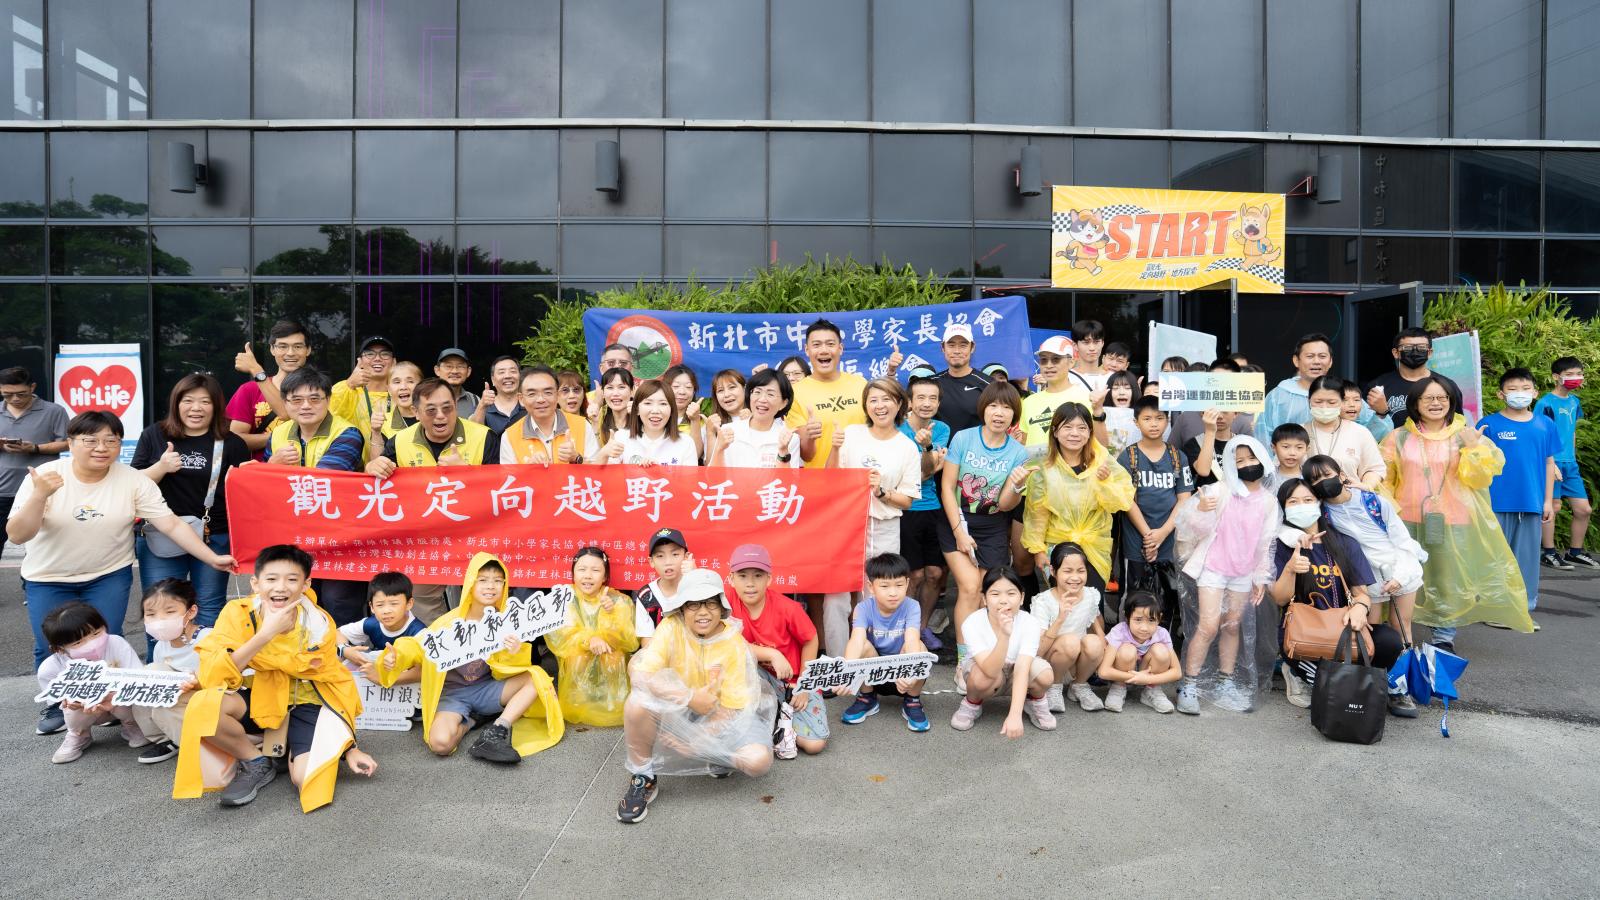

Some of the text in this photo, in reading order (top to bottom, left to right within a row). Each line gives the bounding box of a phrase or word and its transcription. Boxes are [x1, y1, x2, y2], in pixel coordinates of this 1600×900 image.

[1104, 210, 1237, 260] START
[688, 308, 1003, 352] 新北市中學家長協會
[1161, 389, 1264, 401] 台灣運動創生協會
[965, 451, 1009, 472] POPEYE
[287, 474, 805, 525] 觀光定向越野活動
[440, 619, 565, 669] Dare to Move Experience
[64, 662, 103, 681] 觀光
[796, 672, 857, 692] 定向越野
[868, 662, 928, 682] 地方探索
[807, 660, 843, 677] 觀光
[43, 681, 109, 704] 定向越野
[116, 682, 180, 703] 地方探索
[361, 685, 422, 704] 下的浪
[371, 706, 411, 714] DATUNSHAN
